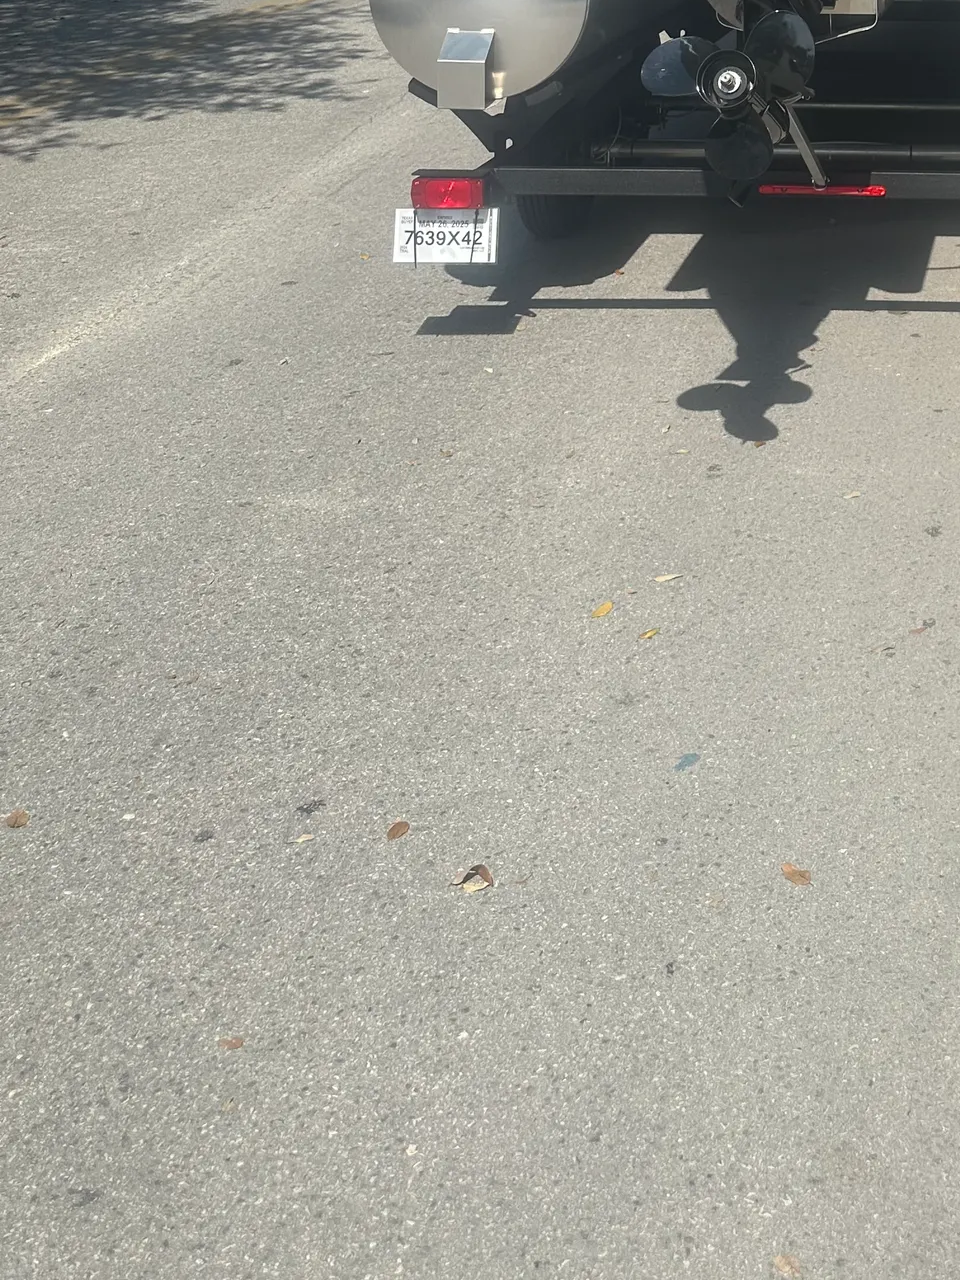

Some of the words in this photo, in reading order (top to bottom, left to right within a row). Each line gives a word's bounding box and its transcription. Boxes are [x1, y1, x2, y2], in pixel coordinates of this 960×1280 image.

[418, 220, 436, 228] MAY
[451, 220, 470, 228] 2025
[404, 230, 483, 246] 7639X42
